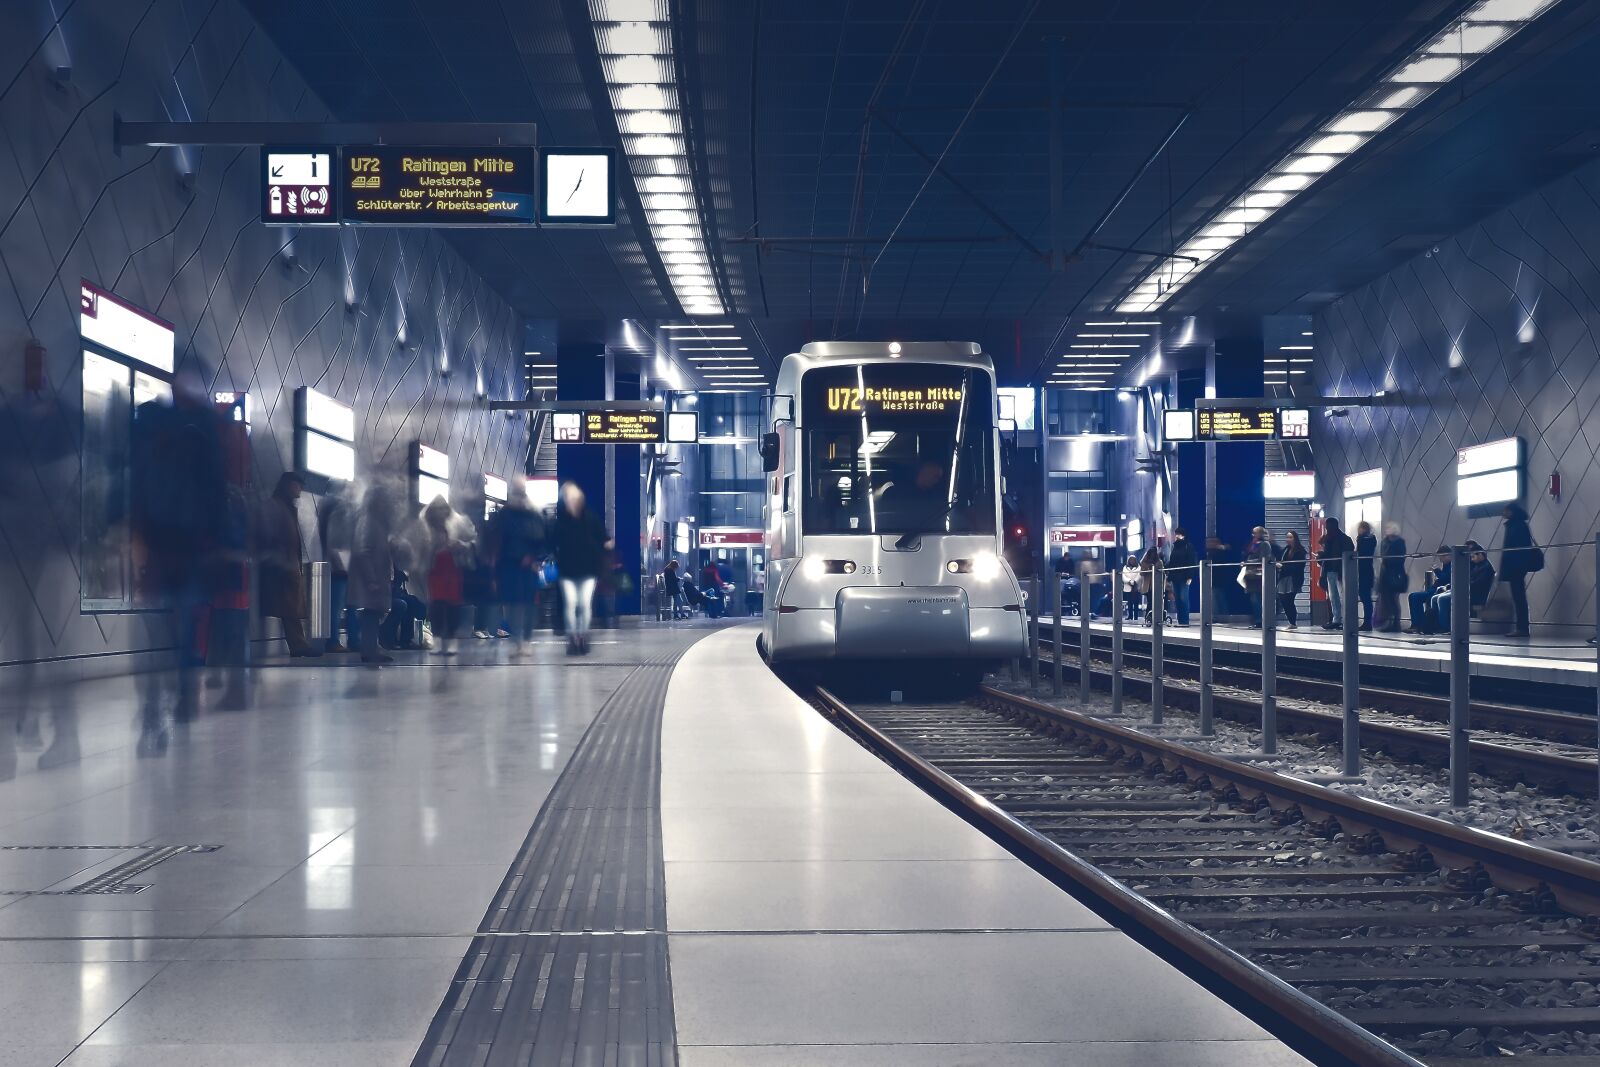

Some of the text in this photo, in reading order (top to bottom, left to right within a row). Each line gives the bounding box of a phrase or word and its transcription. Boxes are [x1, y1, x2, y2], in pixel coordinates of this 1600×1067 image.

[351, 157, 514, 175] U72 Ratingen Mitte
[420, 176, 481, 188] Weststraße
[399, 188, 493, 198] über Wehrhahn S
[304, 206, 326, 214] Notruf
[357, 200, 422, 210] Schlüterstr.
[436, 200, 519, 212] Arbeitsagentur
[828, 388, 862, 410] U72
[865, 388, 962, 401] Ratingen Mitte
[882, 401, 945, 410] Weststraße
